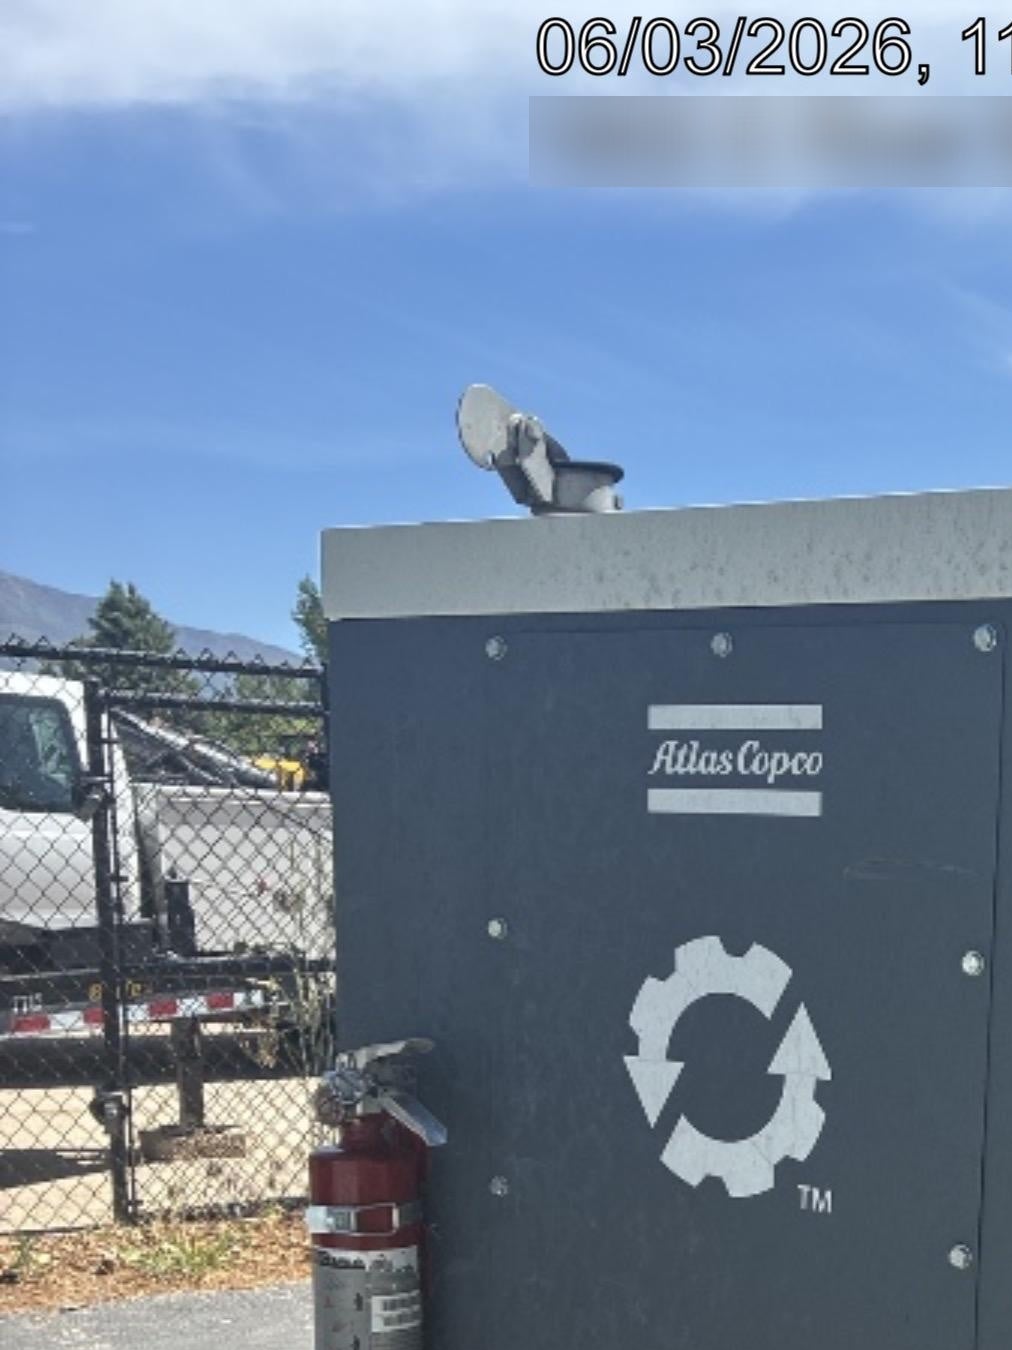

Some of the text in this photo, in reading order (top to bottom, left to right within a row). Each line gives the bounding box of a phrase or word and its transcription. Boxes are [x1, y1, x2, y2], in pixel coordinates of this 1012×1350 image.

[647, 739, 824, 784] Atlas Copco
[796, 1183, 833, 1213] TM
